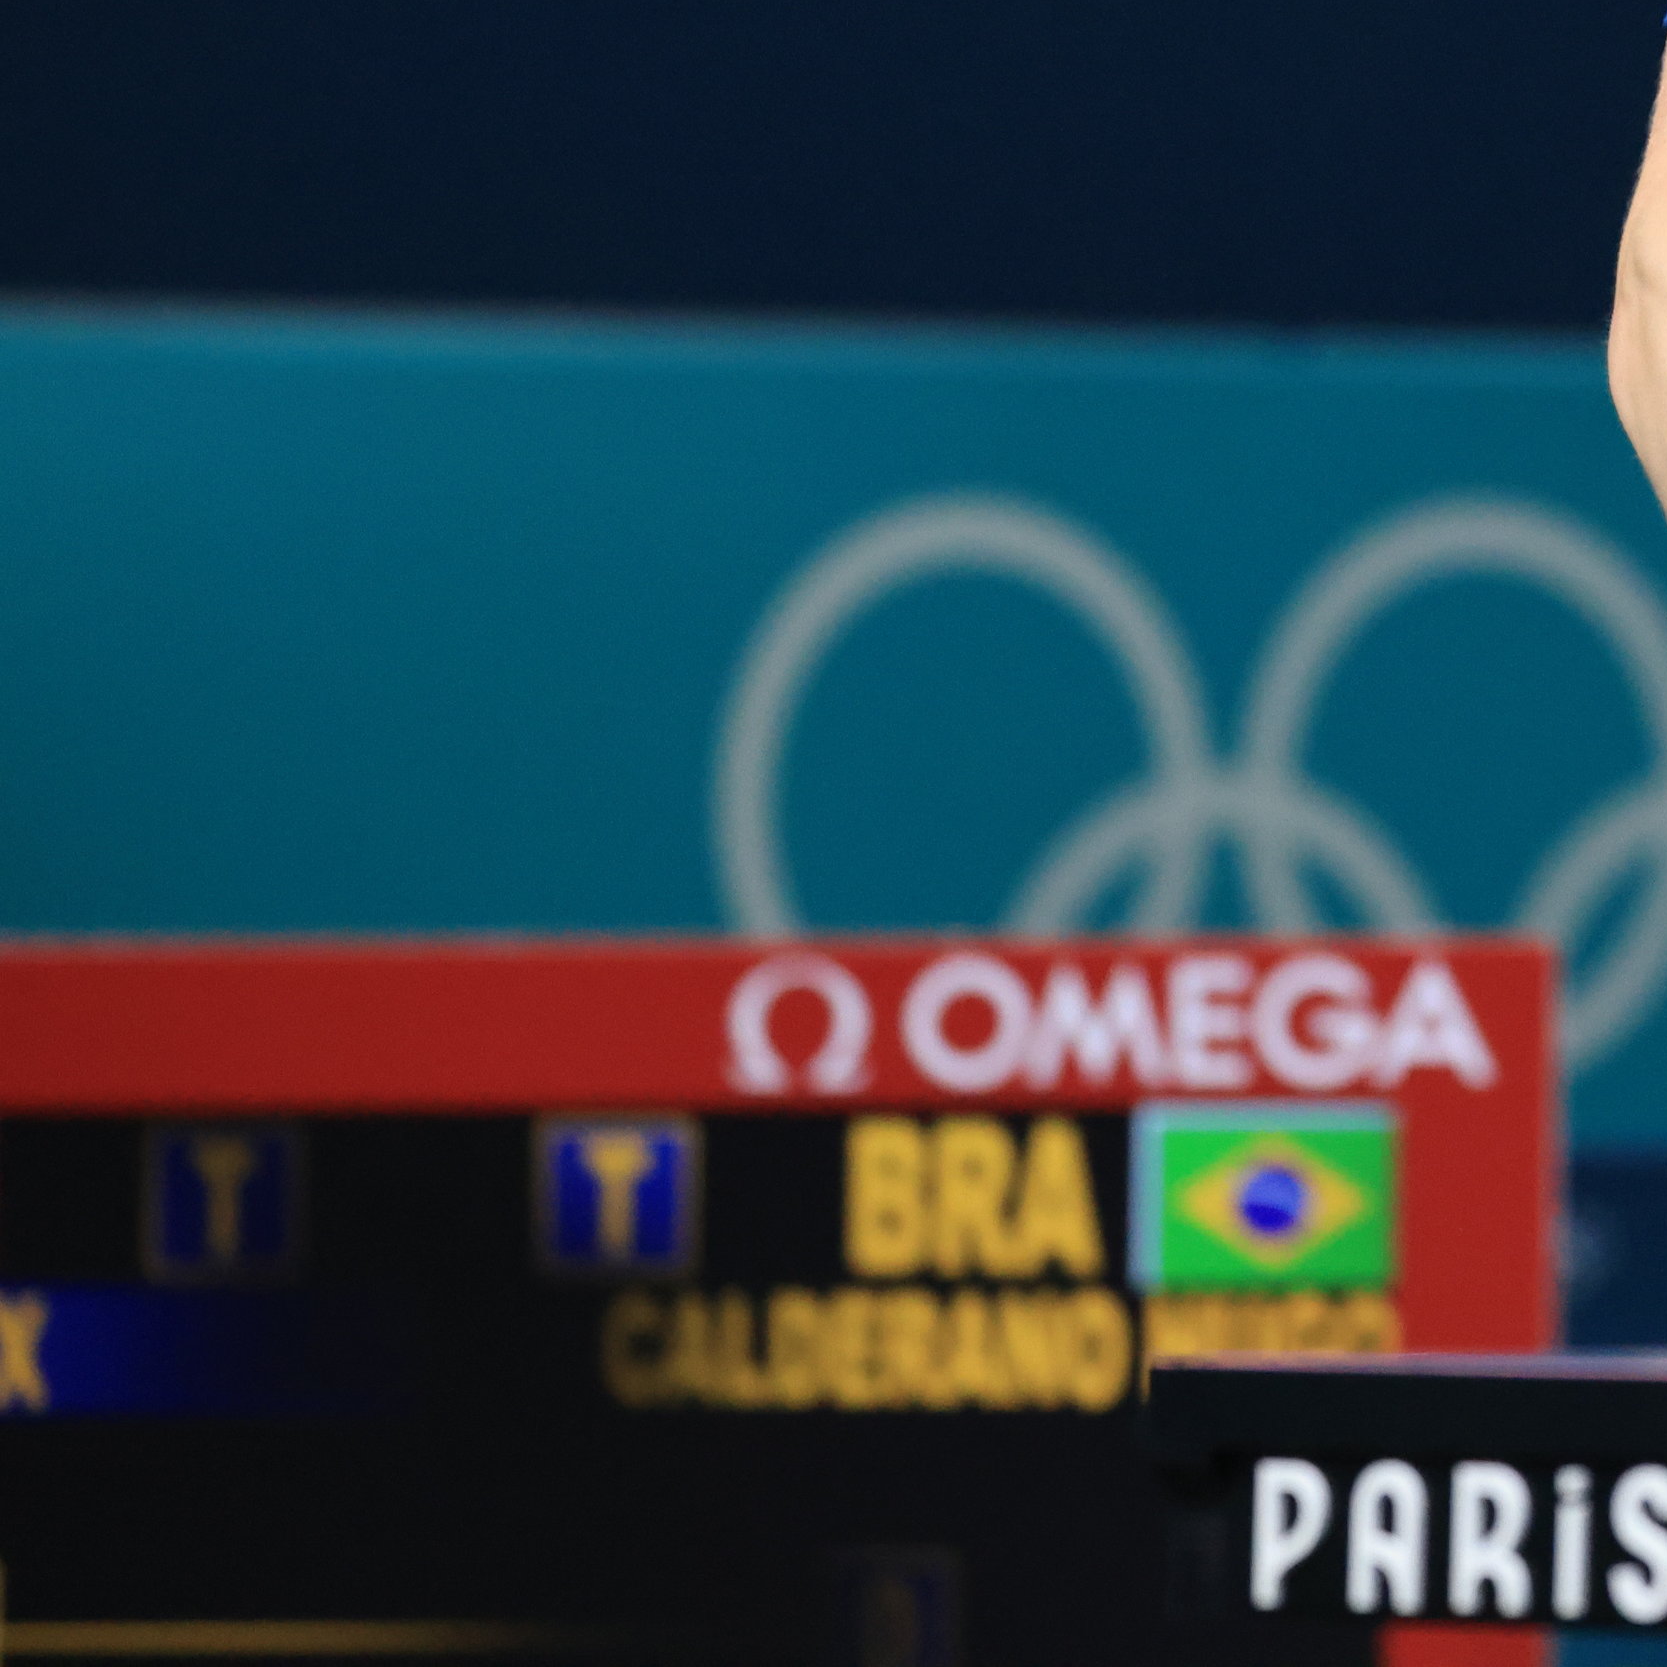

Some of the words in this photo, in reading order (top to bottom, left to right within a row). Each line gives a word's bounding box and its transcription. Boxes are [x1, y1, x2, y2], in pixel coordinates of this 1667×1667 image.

[899, 951, 1498, 1092] OMEGA
[579, 1130, 656, 1262] T
[842, 1114, 1108, 1280] BRA
[603, 1284, 1134, 1414] CALDERANO
